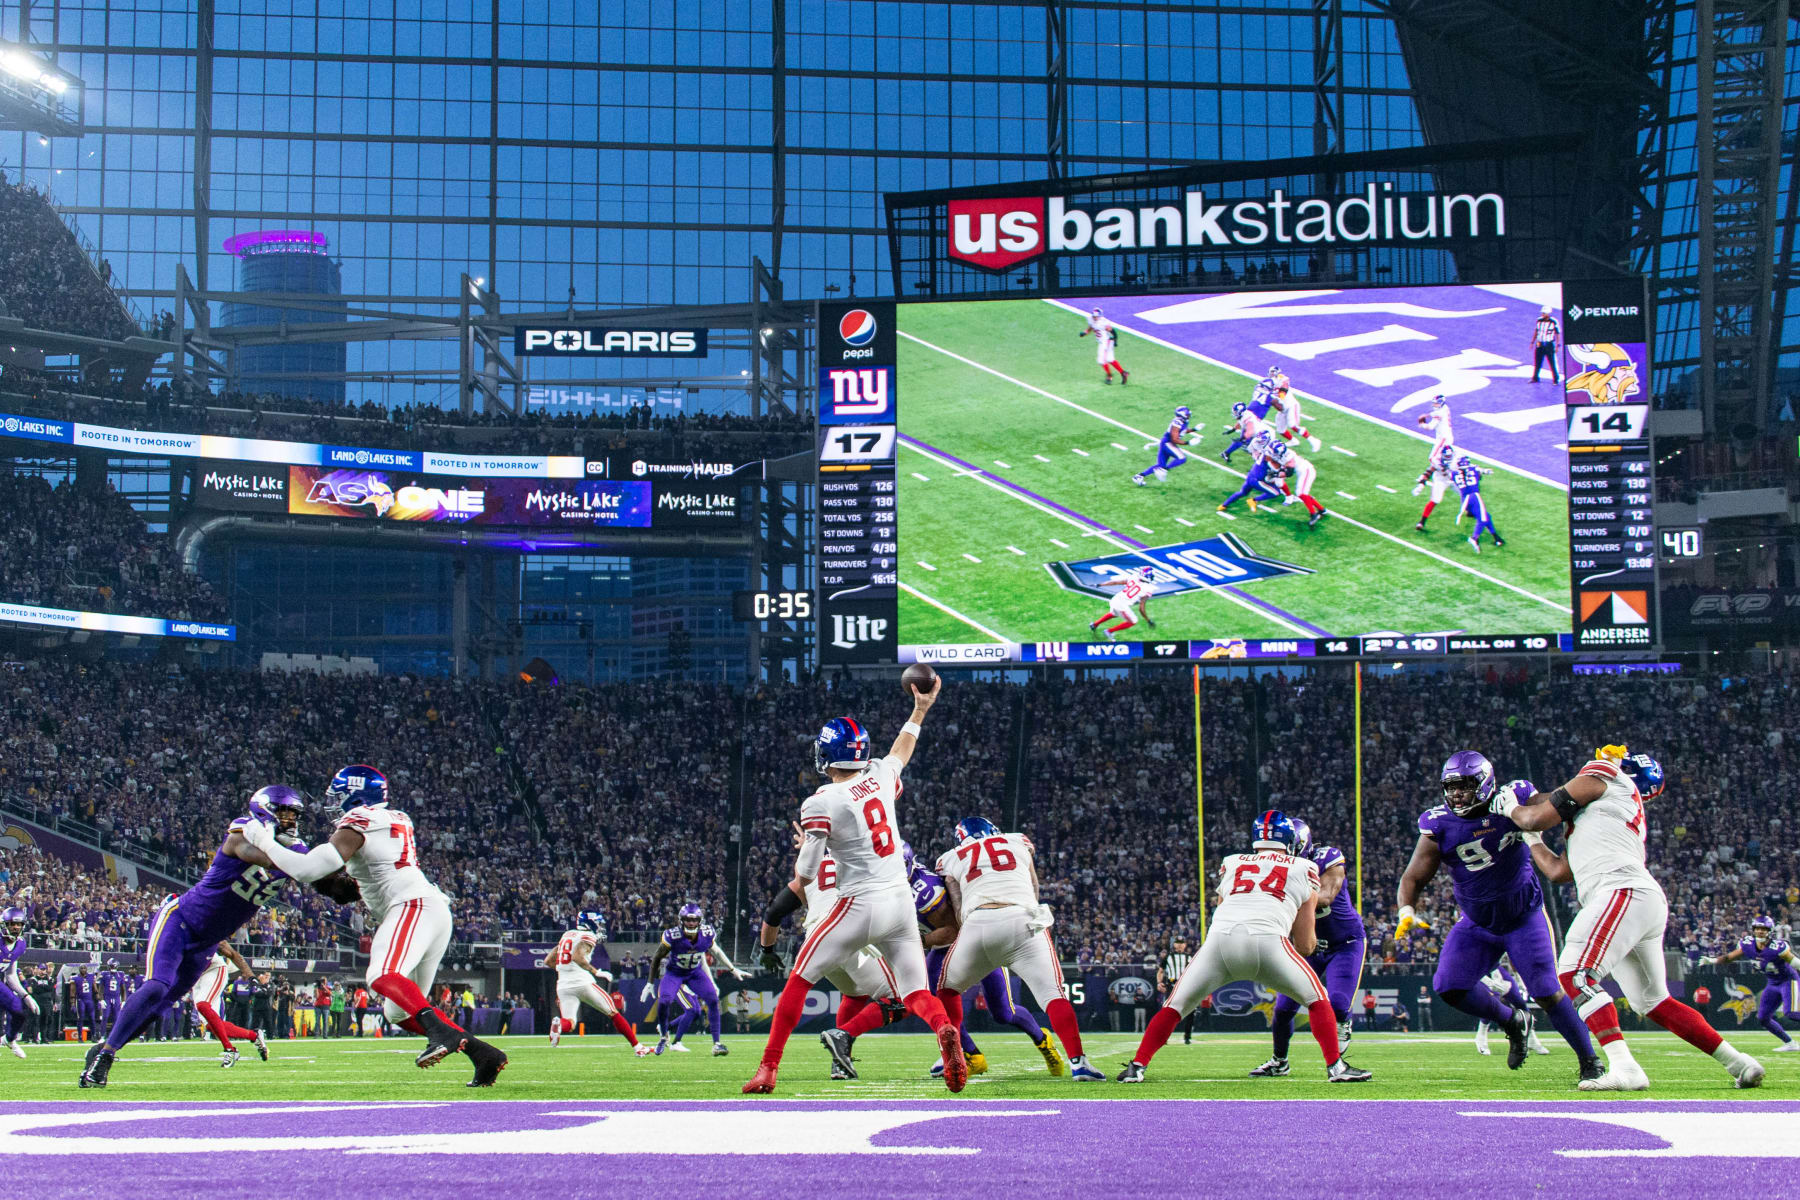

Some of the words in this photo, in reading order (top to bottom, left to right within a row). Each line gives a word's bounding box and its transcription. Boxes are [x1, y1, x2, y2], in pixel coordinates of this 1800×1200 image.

[1585, 306, 1639, 317] PENTAIR
[525, 330, 696, 352] POLARIS
[843, 348, 873, 359] pepsi
[829, 369, 887, 415] ny
[1582, 412, 1632, 433] 14
[81, 430, 119, 442] ROOTED
[122, 436, 131, 444] IN
[835, 433, 881, 453] 17
[331, 450, 354, 462] LAND
[431, 459, 467, 468] ROOTED
[471, 461, 480, 469] IN
[649, 464, 692, 473] TRAINING
[694, 463, 734, 476] HAUS
[1571, 465, 1592, 473] RUSH
[1593, 464, 1609, 472] YDS
[1628, 462, 1644, 473] 44
[824, 483, 842, 491] RUSH
[843, 483, 859, 491] YDS
[875, 482, 893, 491] 126
[1592, 480, 1608, 488] YDS
[1627, 479, 1646, 488] 130
[305, 481, 368, 506] AS
[397, 486, 485, 512] ONE
[875, 497, 893, 507] 130
[1572, 496, 1597, 504] TOTAL
[1597, 496, 1613, 504] YDS
[1628, 494, 1647, 504] 174
[561, 511, 589, 519] CASINO
[824, 514, 844, 522] TOTAL
[846, 514, 861, 522] YDS
[875, 513, 894, 522] 256
[1573, 512, 1586, 520] 1ST
[1587, 512, 1616, 520] DOWNS
[1631, 511, 1644, 520] 12
[837, 529, 864, 537] DOWNS
[878, 528, 890, 537] 13
[1573, 528, 1607, 536] PEN/YDS
[1628, 526, 1649, 536] 0/0
[824, 545, 855, 553] PEN/YDS
[872, 543, 896, 553] 4/30
[1574, 544, 1620, 552] TURNOVERS
[1635, 542, 1642, 552] 0
[1663, 530, 1699, 556] 40
[824, 560, 867, 568] TURNOVERS
[881, 559, 888, 568] 0
[1574, 560, 1597, 568] T.O.P.
[873, 574, 896, 584] 16:15
[1122, 580, 1142, 599] 80
[754, 592, 810, 618] 0:35
[1, 608, 29, 616] ROOTED
[172, 623, 188, 632] LAND
[830, 614, 888, 649] Lite
[1580, 627, 1649, 639] ANDERSEN
[1261, 641, 1298, 653] MIN
[1325, 641, 1348, 652] 14
[1412, 638, 1438, 651] 10
[1450, 640, 1490, 649] BALL
[1493, 639, 1516, 648] ON
[1523, 638, 1547, 649] 10
[922, 648, 960, 658] WILD
[964, 647, 1005, 658] CARD
[1087, 644, 1129, 656] NYG
[1154, 644, 1176, 655] 17
[855, 749, 861, 758] 8
[849, 777, 881, 801] JONES
[862, 797, 896, 859] 8
[1259, 830, 1273, 839] 64
[956, 837, 1017, 882] 76
[1229, 864, 1289, 903] 64
[82, 982, 90, 993] 2
